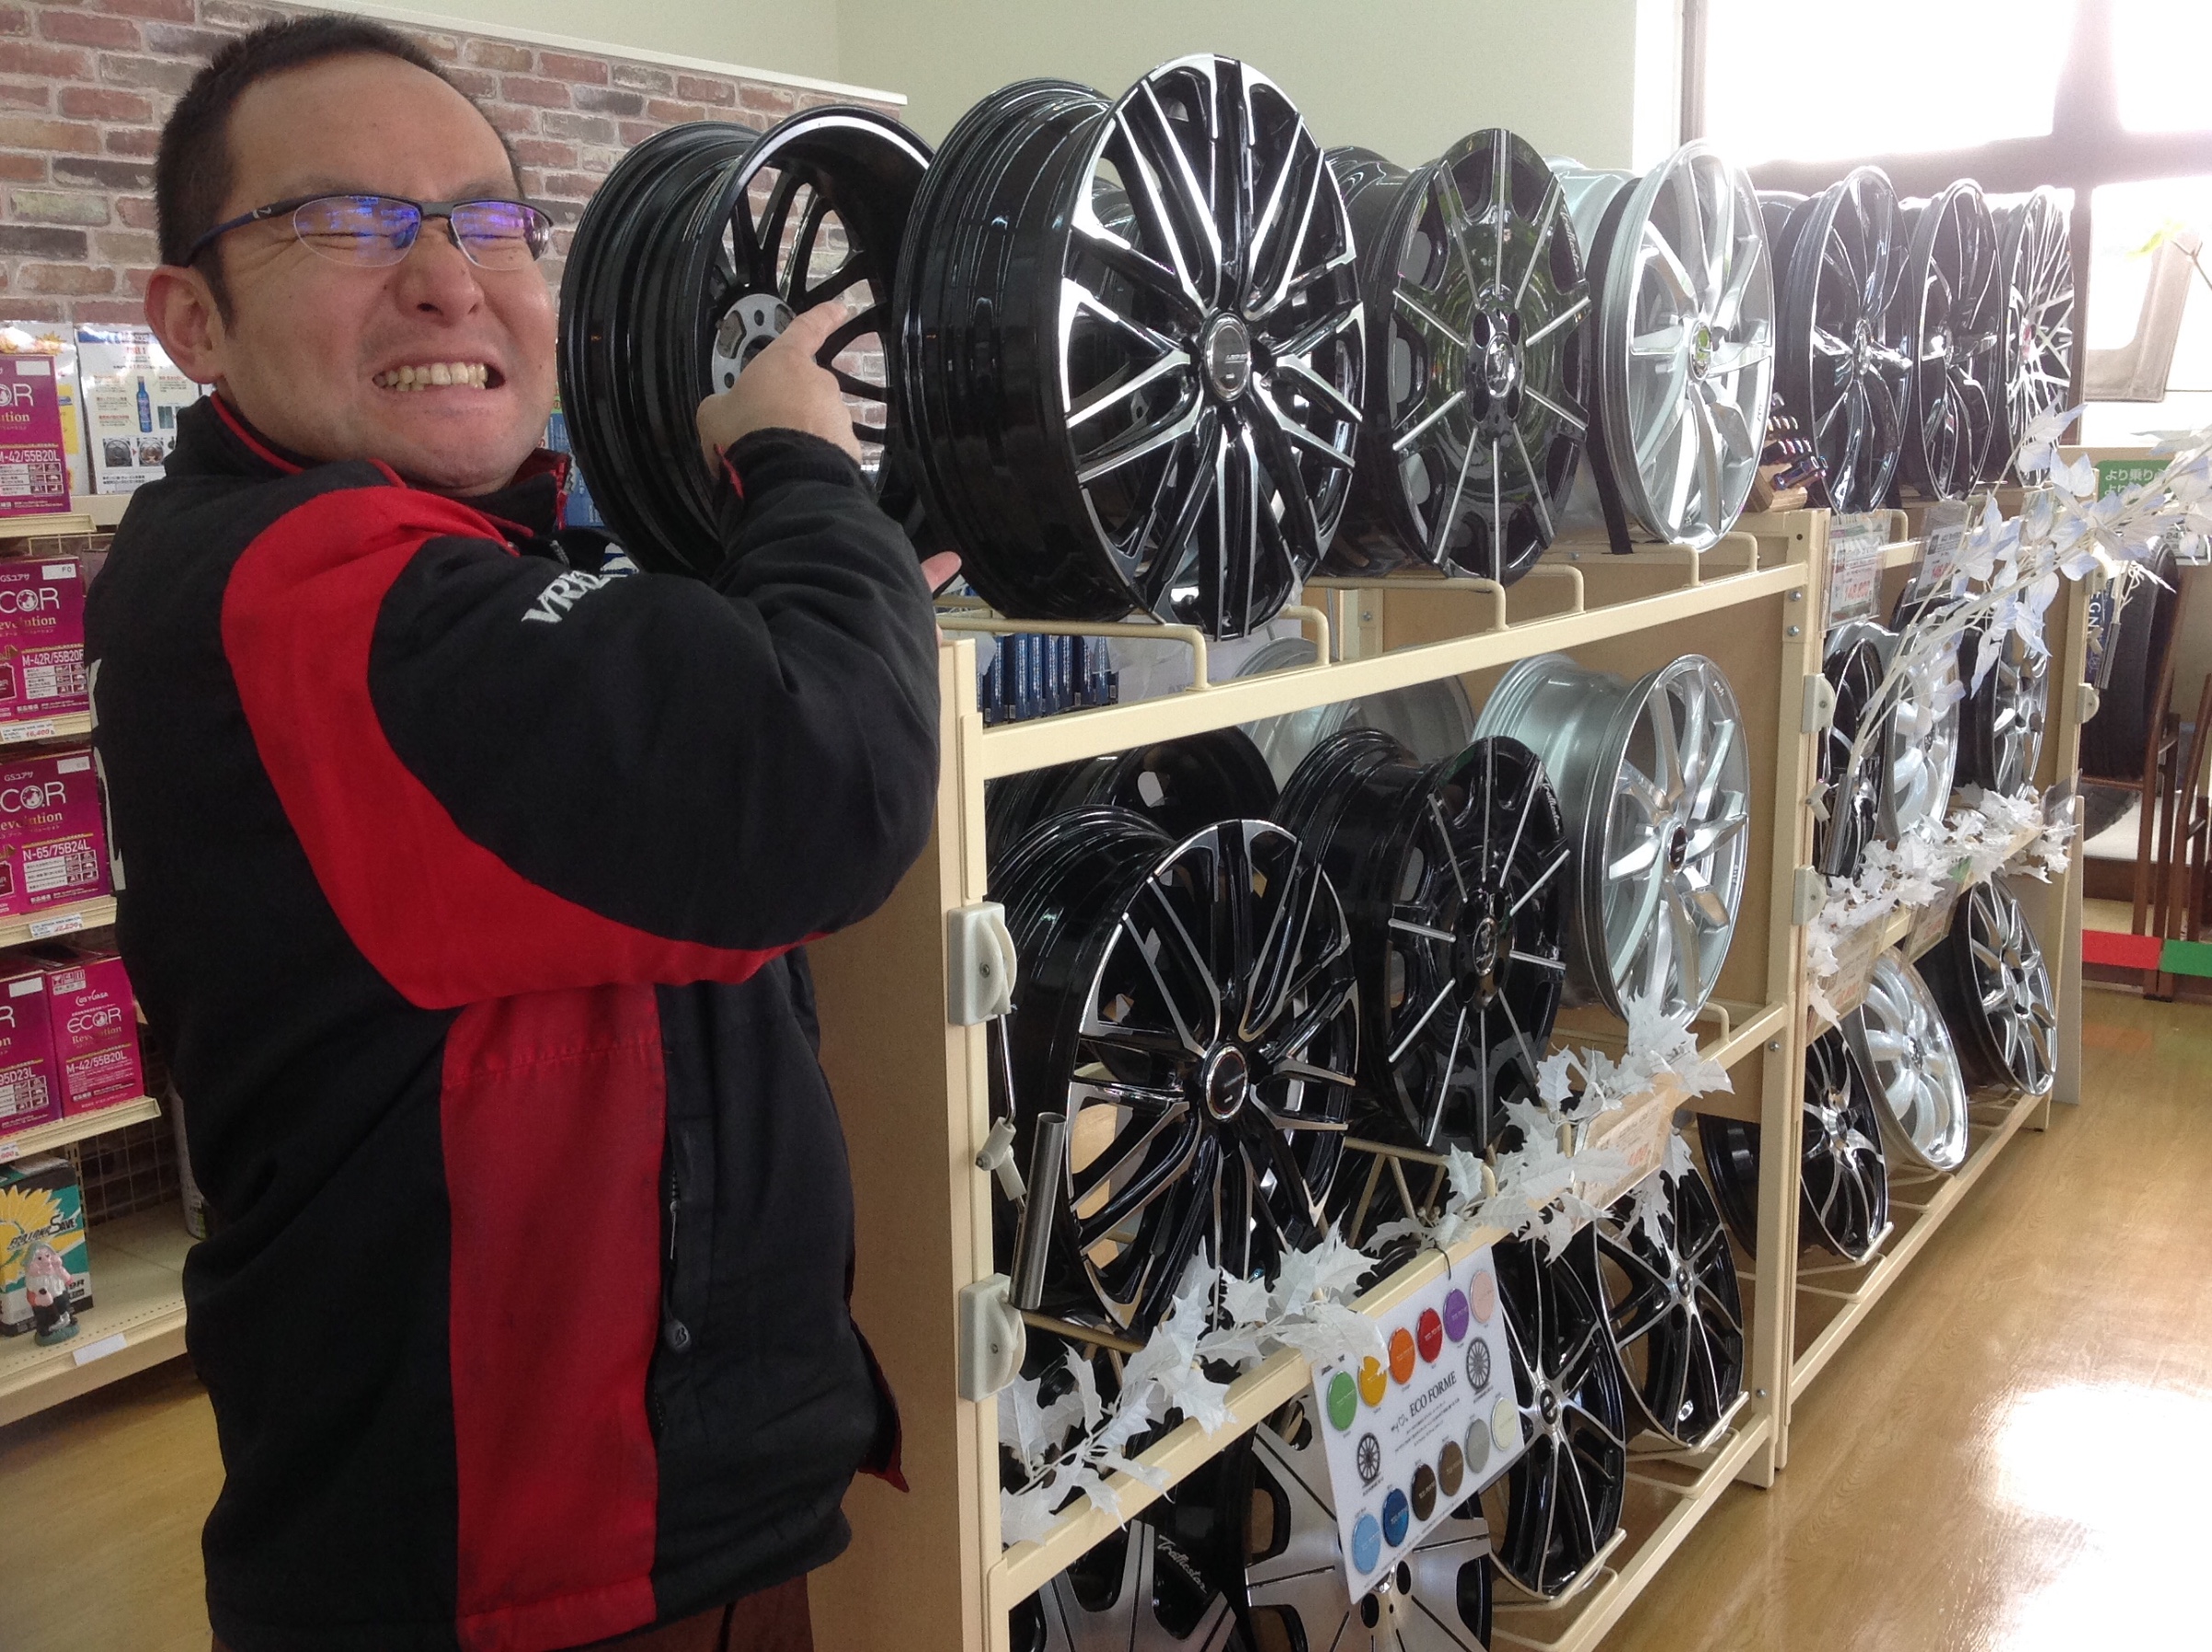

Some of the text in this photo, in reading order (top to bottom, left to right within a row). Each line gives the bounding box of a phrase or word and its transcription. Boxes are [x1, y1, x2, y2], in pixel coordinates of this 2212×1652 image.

[2105, 468, 2167, 481] より乗り
[1409, 1394, 1427, 1417] ECO
[1427, 1371, 1457, 1403] FORME
